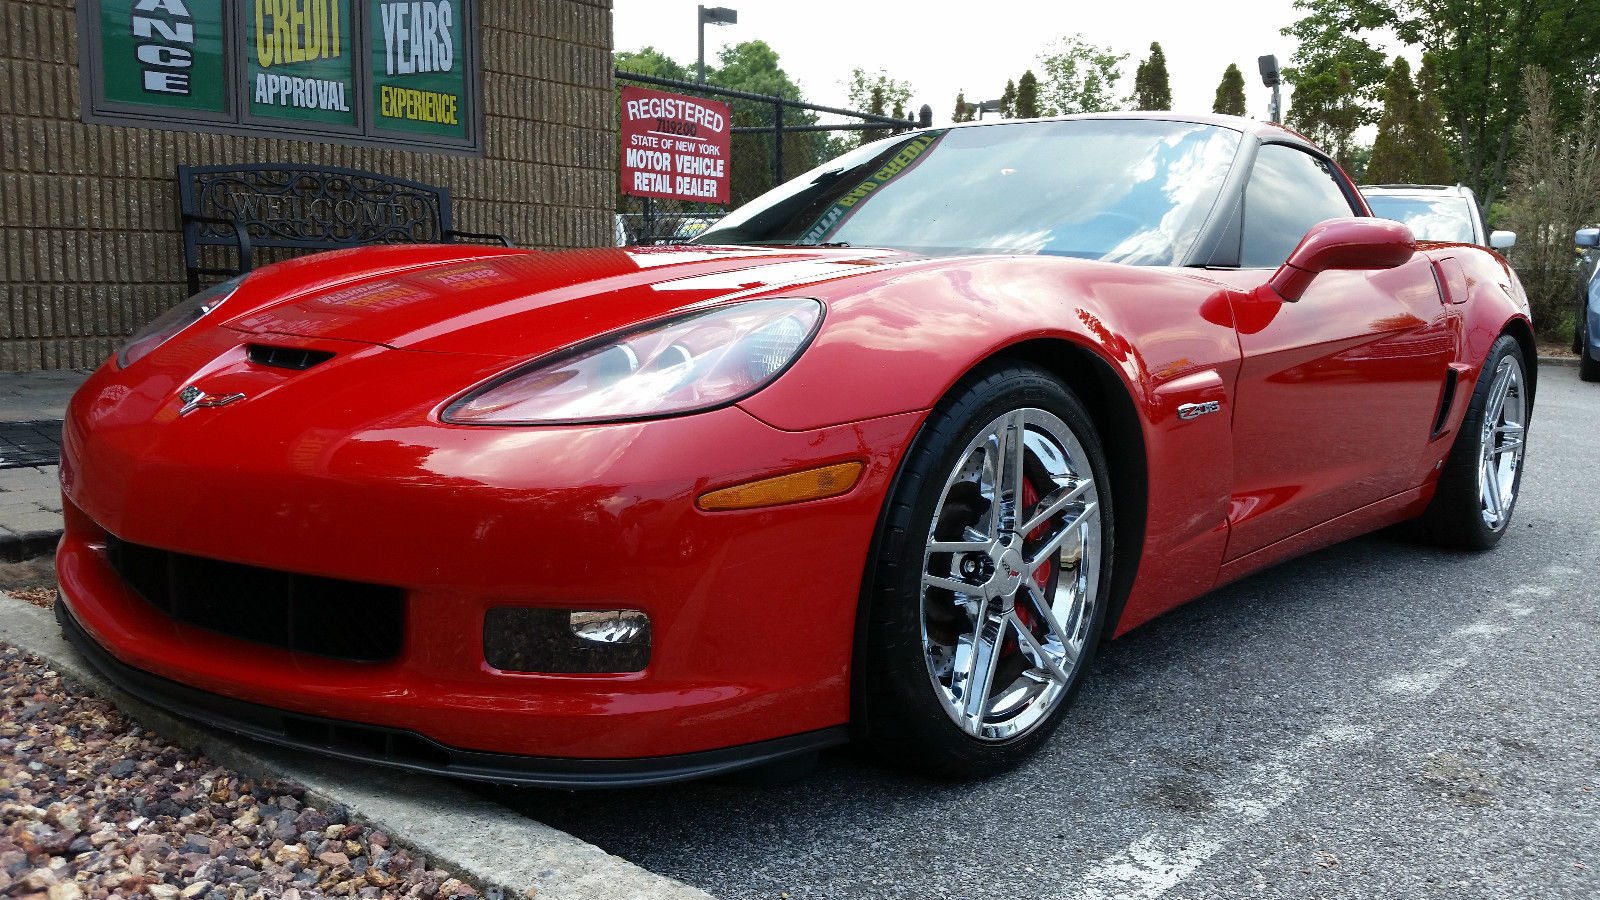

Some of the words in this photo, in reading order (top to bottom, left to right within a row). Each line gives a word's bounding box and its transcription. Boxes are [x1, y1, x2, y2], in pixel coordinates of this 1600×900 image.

[255, 0, 340, 68] CREDIT
[381, 0, 453, 75] YEARS
[255, 73, 350, 112] APPROVAL
[381, 85, 458, 125] EXPERIENCE
[626, 97, 724, 133] REGISTERED
[626, 148, 671, 172] MOTOR
[675, 154, 725, 178] VEHICLE
[631, 134, 659, 148] STATE
[661, 138, 674, 150] OF
[676, 140, 696, 153] NEW
[698, 143, 720, 156] YORK
[634, 171, 673, 194] RETAIL
[676, 176, 717, 198] DEALER
[229, 192, 408, 228] WELCOME
[1177, 400, 1219, 420] Z06
